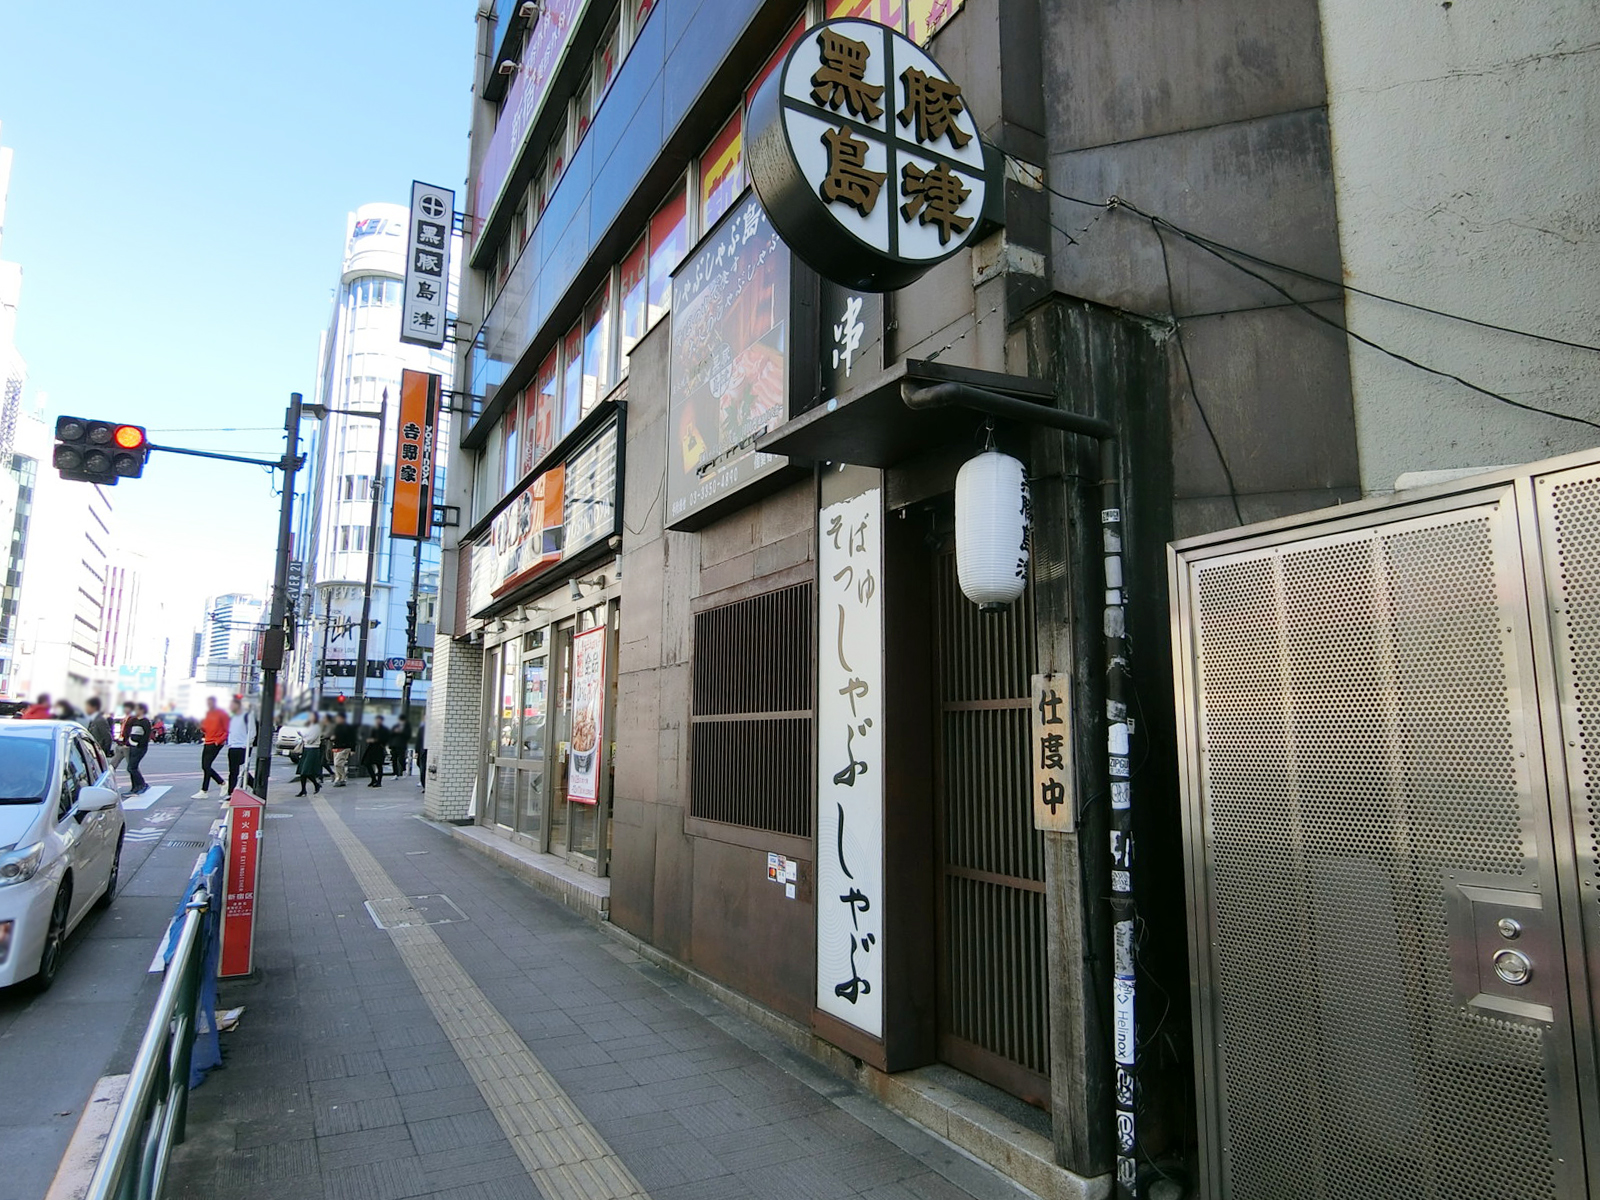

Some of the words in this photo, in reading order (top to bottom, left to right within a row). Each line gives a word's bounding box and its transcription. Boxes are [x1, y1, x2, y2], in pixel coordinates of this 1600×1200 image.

[809, 26, 973, 150] 黒豚
[819, 123, 975, 246] 島津
[411, 223, 442, 331] 黒豚島津
[673, 202, 767, 314] しゃぶしゃぶ島
[399, 421, 421, 484] 吉野家
[826, 511, 870, 554] そば
[833, 561, 875, 608] つゆ
[393, 659, 404, 667] 20
[1038, 689, 1065, 816] 仕度中
[241, 810, 251, 840] 消火器
[832, 601, 876, 1006] しゃぶしゃぶ
[1117, 1010, 1128, 1058] Helinox
